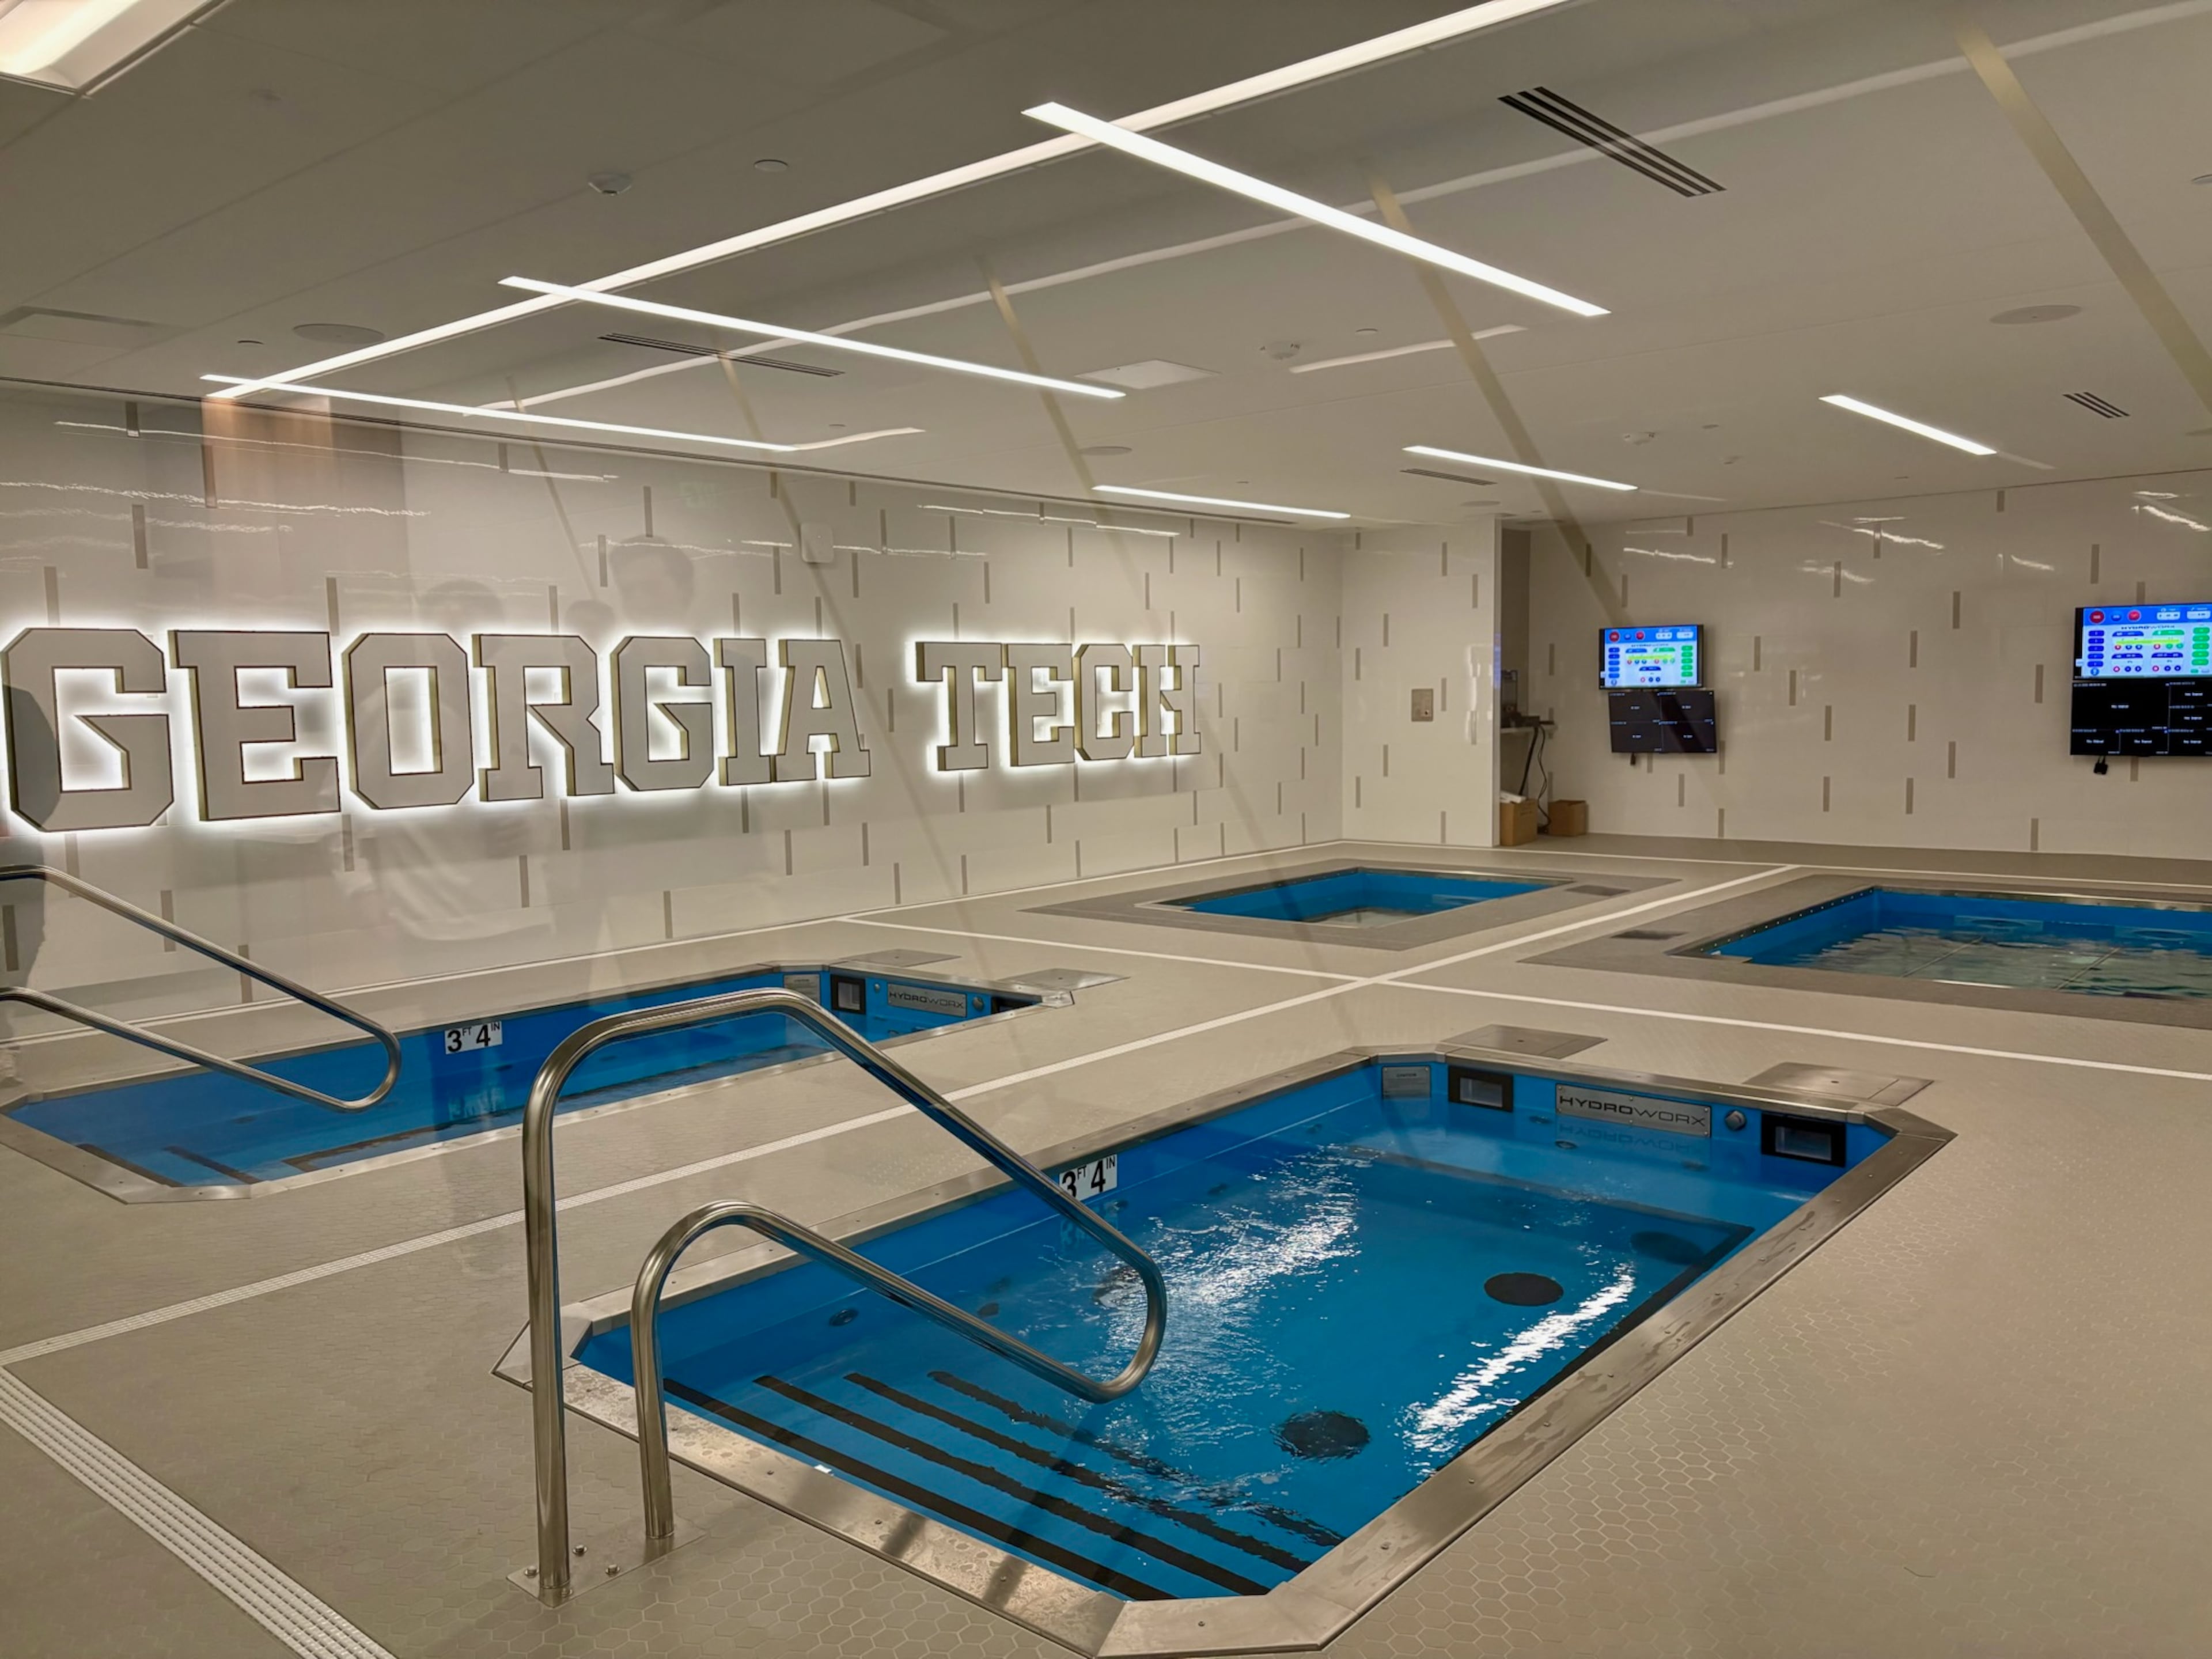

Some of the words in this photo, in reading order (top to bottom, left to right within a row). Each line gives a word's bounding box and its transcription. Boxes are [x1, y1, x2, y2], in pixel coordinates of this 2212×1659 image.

[0, 627, 871, 832] GEORGIA
[915, 641, 1202, 771] TECH
[889, 991, 964, 1009] HYDROWORX
[1559, 1095, 1706, 1127] HYDROWORX
